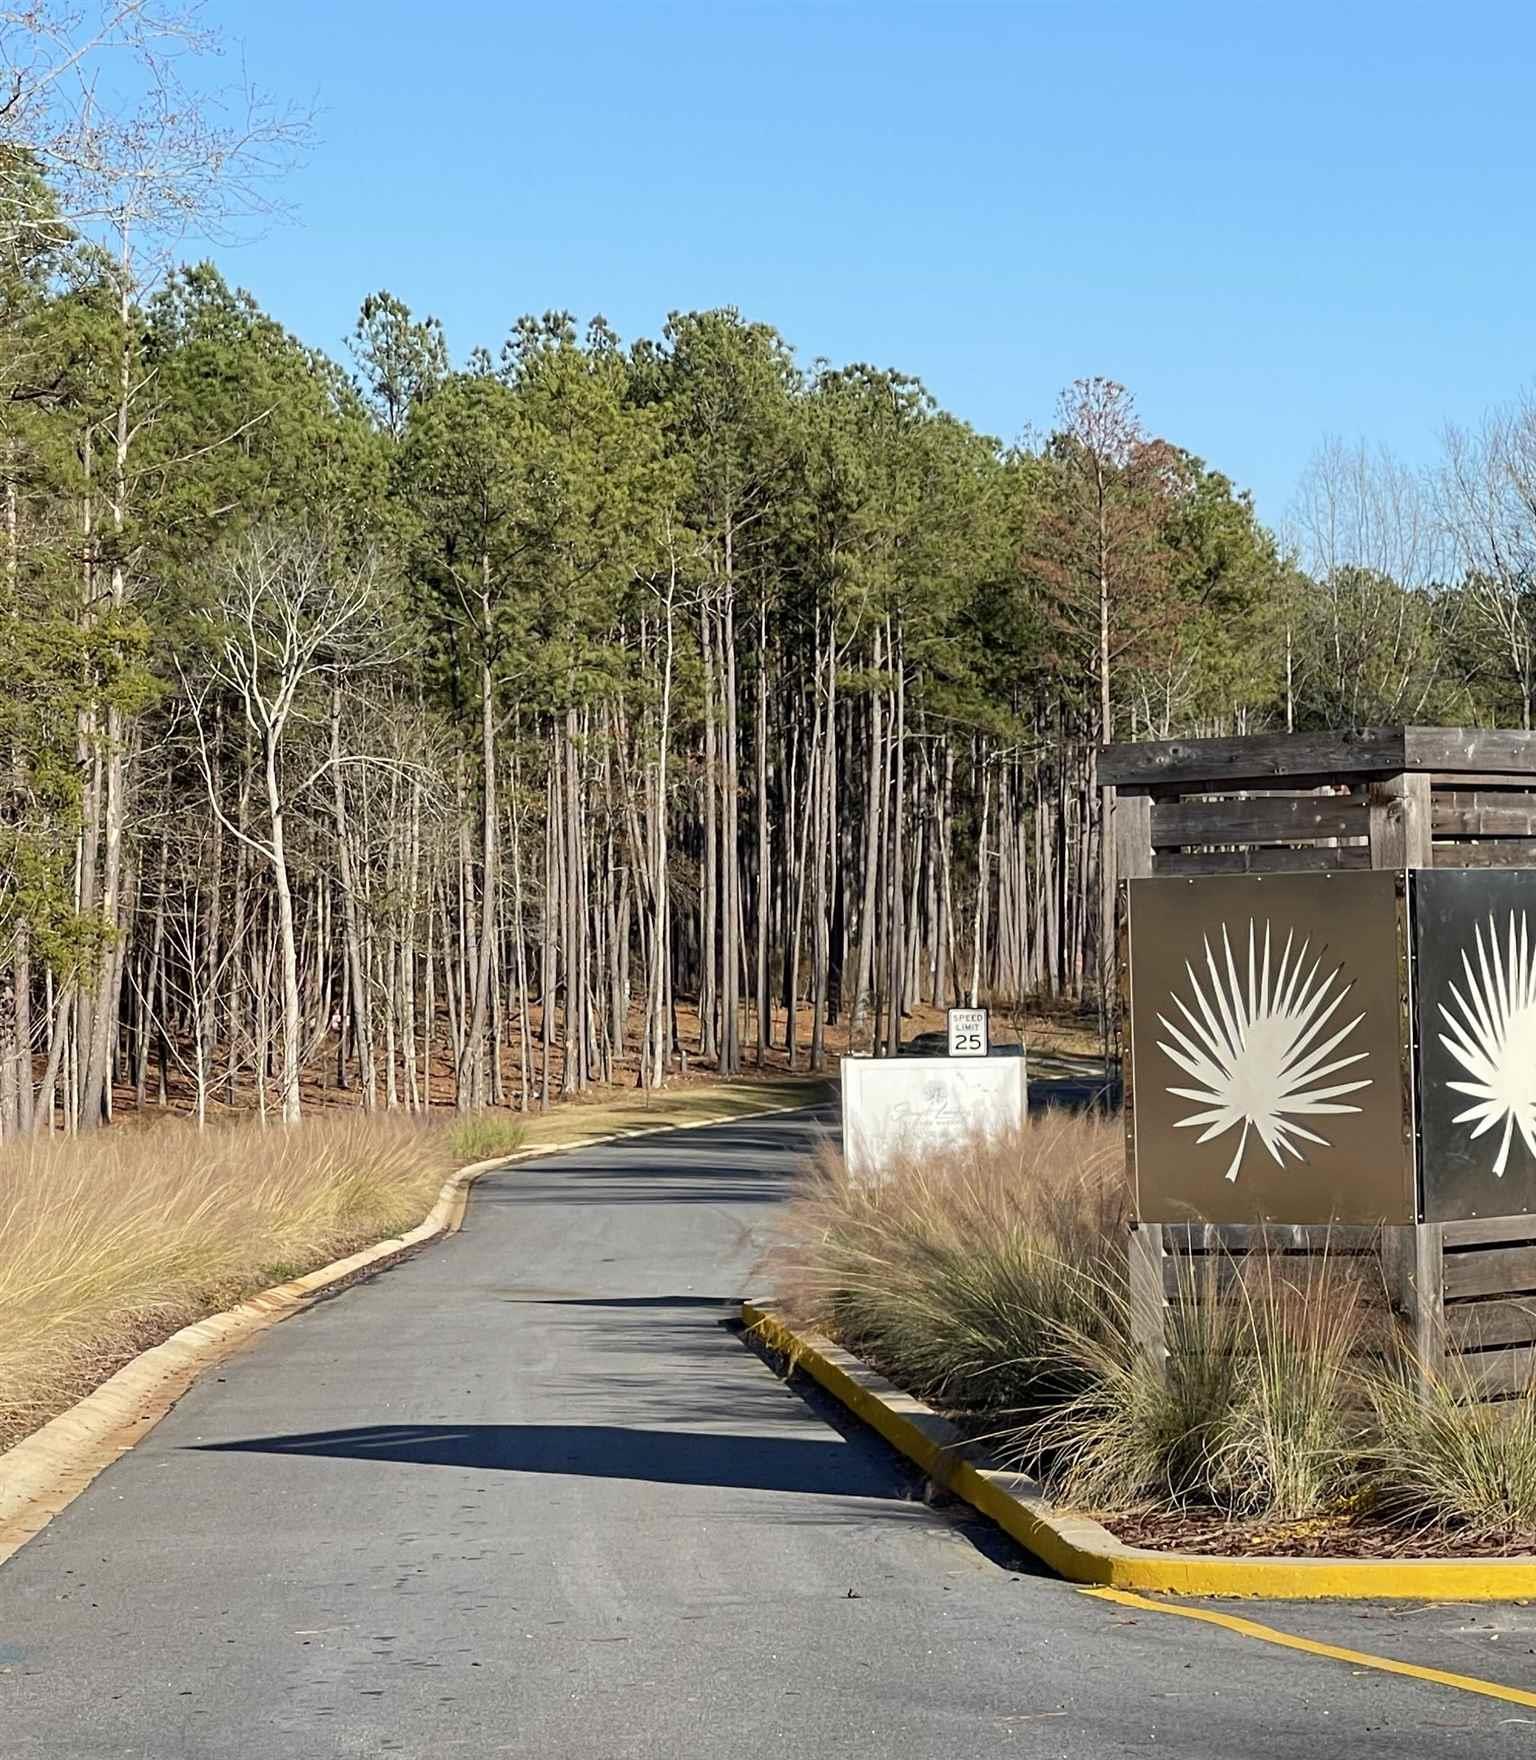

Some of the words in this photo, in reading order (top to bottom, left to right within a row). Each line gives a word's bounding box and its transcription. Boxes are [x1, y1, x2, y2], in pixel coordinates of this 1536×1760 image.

[953, 1014, 983, 1022] SPEED
[956, 1023, 980, 1032] LIMIT
[955, 1034, 982, 1050] 25
